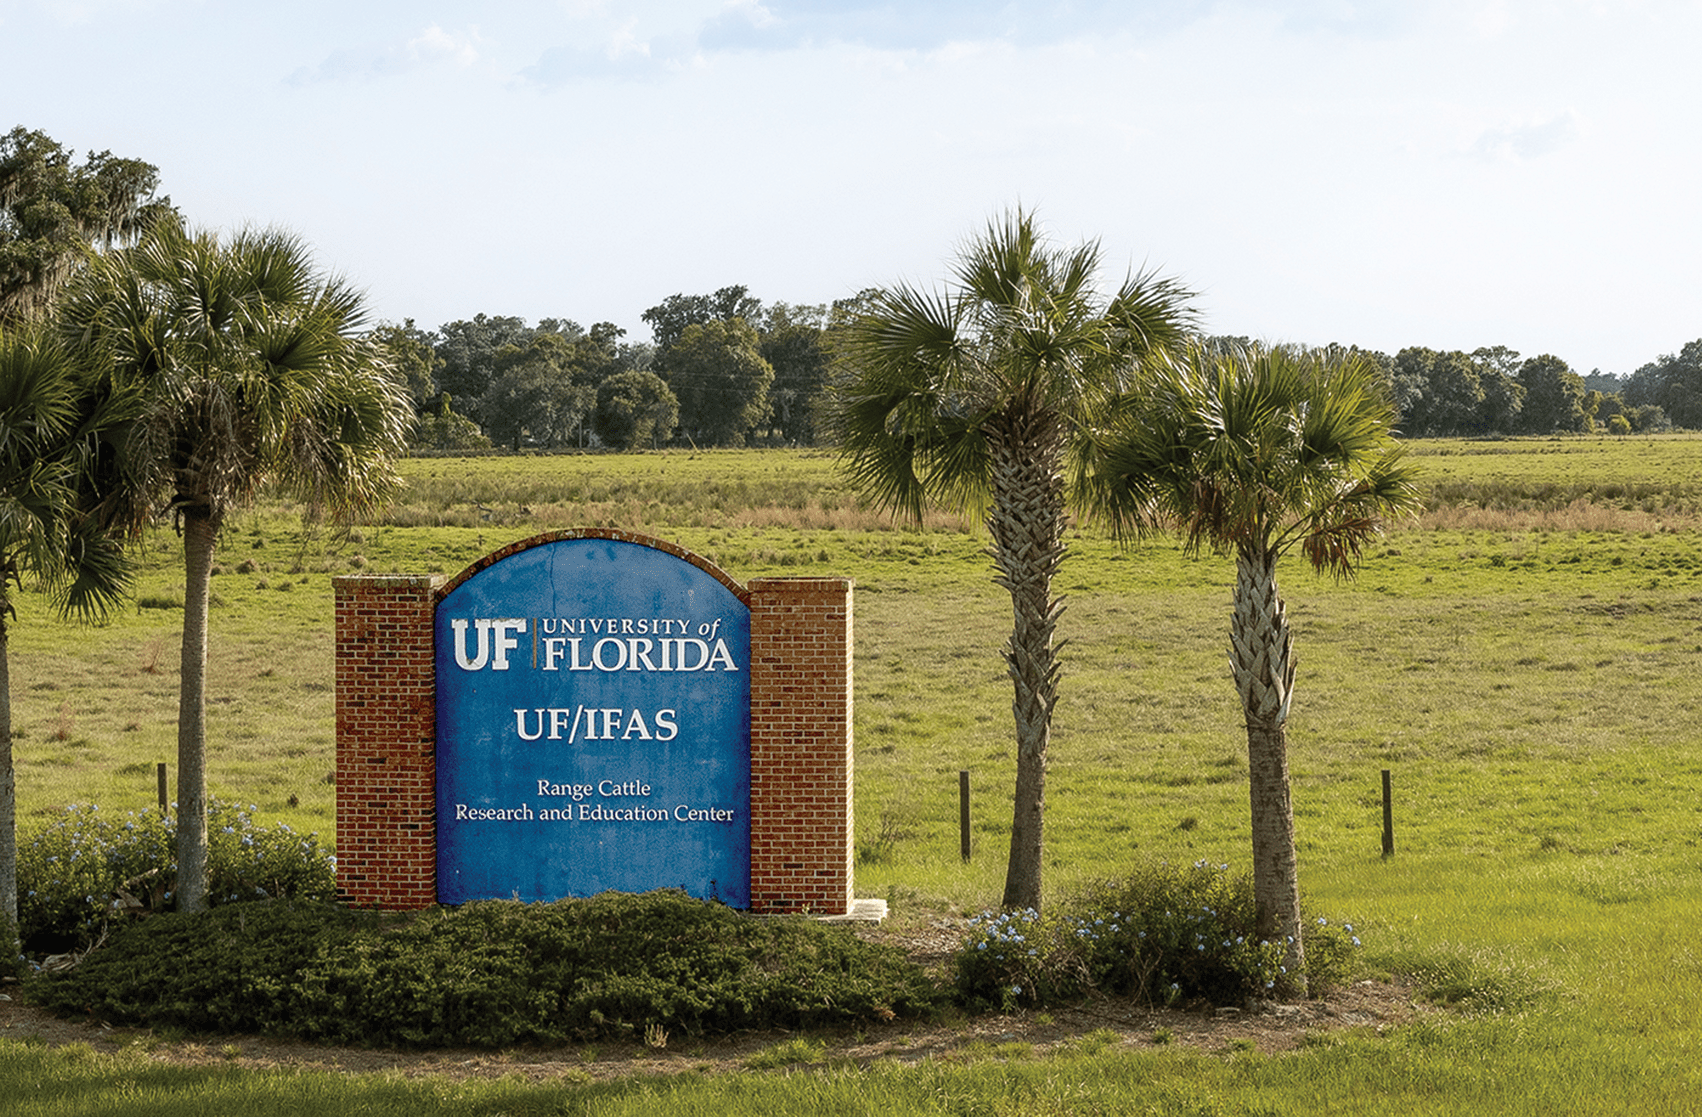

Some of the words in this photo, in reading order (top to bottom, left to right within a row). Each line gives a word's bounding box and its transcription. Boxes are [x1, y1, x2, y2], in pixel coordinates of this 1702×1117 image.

[451, 617, 527, 671] UF
[542, 618, 691, 635] UNIVERSITY
[698, 618, 722, 642] of
[541, 637, 739, 672] FLORIDA
[513, 704, 678, 744] UF/IFAS
[537, 779, 594, 802] Range
[598, 779, 651, 797] Cattle
[455, 803, 534, 821] Research
[539, 804, 573, 821] and
[578, 804, 669, 821] Education
[674, 804, 734, 822] Center
